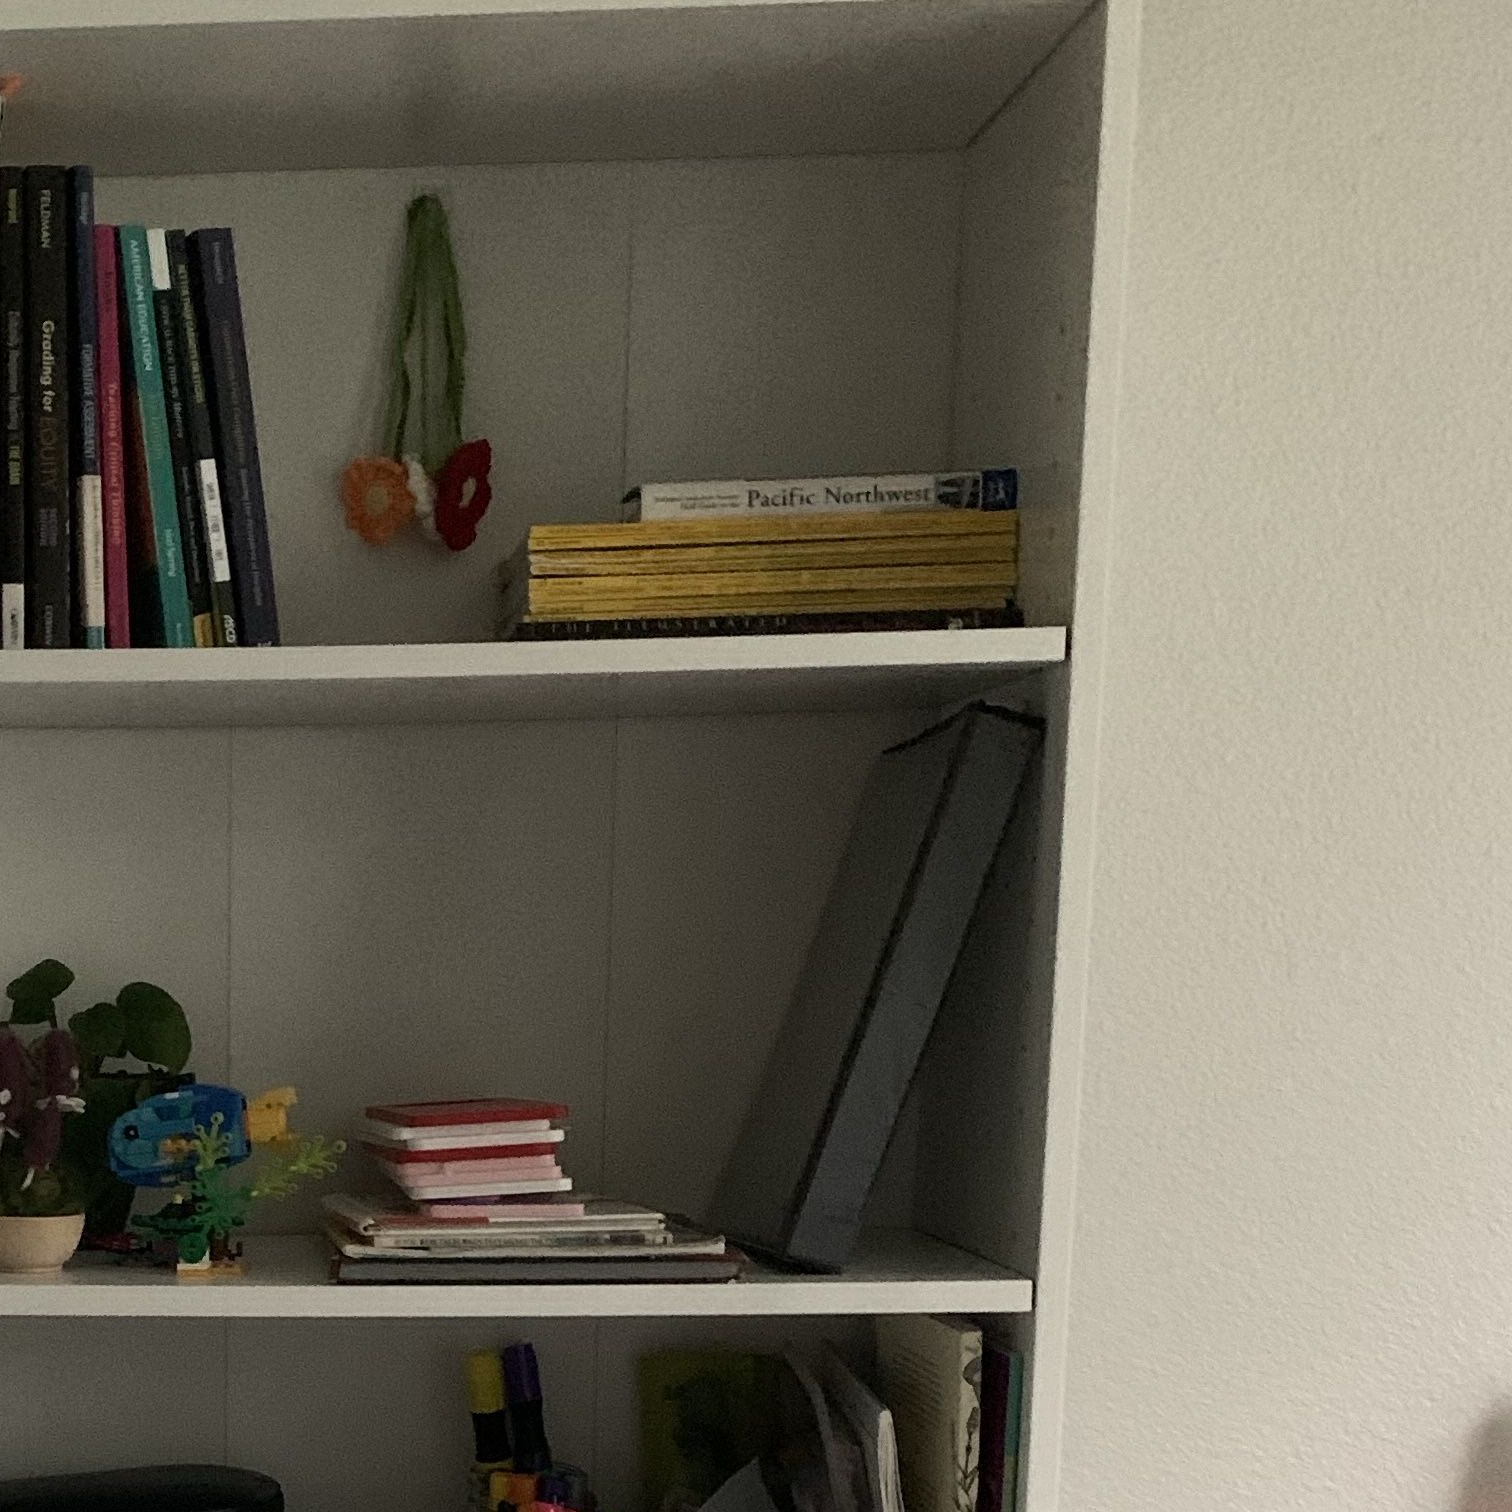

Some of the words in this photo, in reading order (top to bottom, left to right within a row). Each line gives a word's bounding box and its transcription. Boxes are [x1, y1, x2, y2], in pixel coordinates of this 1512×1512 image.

[40, 189, 51, 248] FELDMAN
[41, 320, 54, 385] Grading
[42, 390, 55, 412] for
[746, 488, 817, 510] Pacific
[824, 484, 933, 507] Northwest
